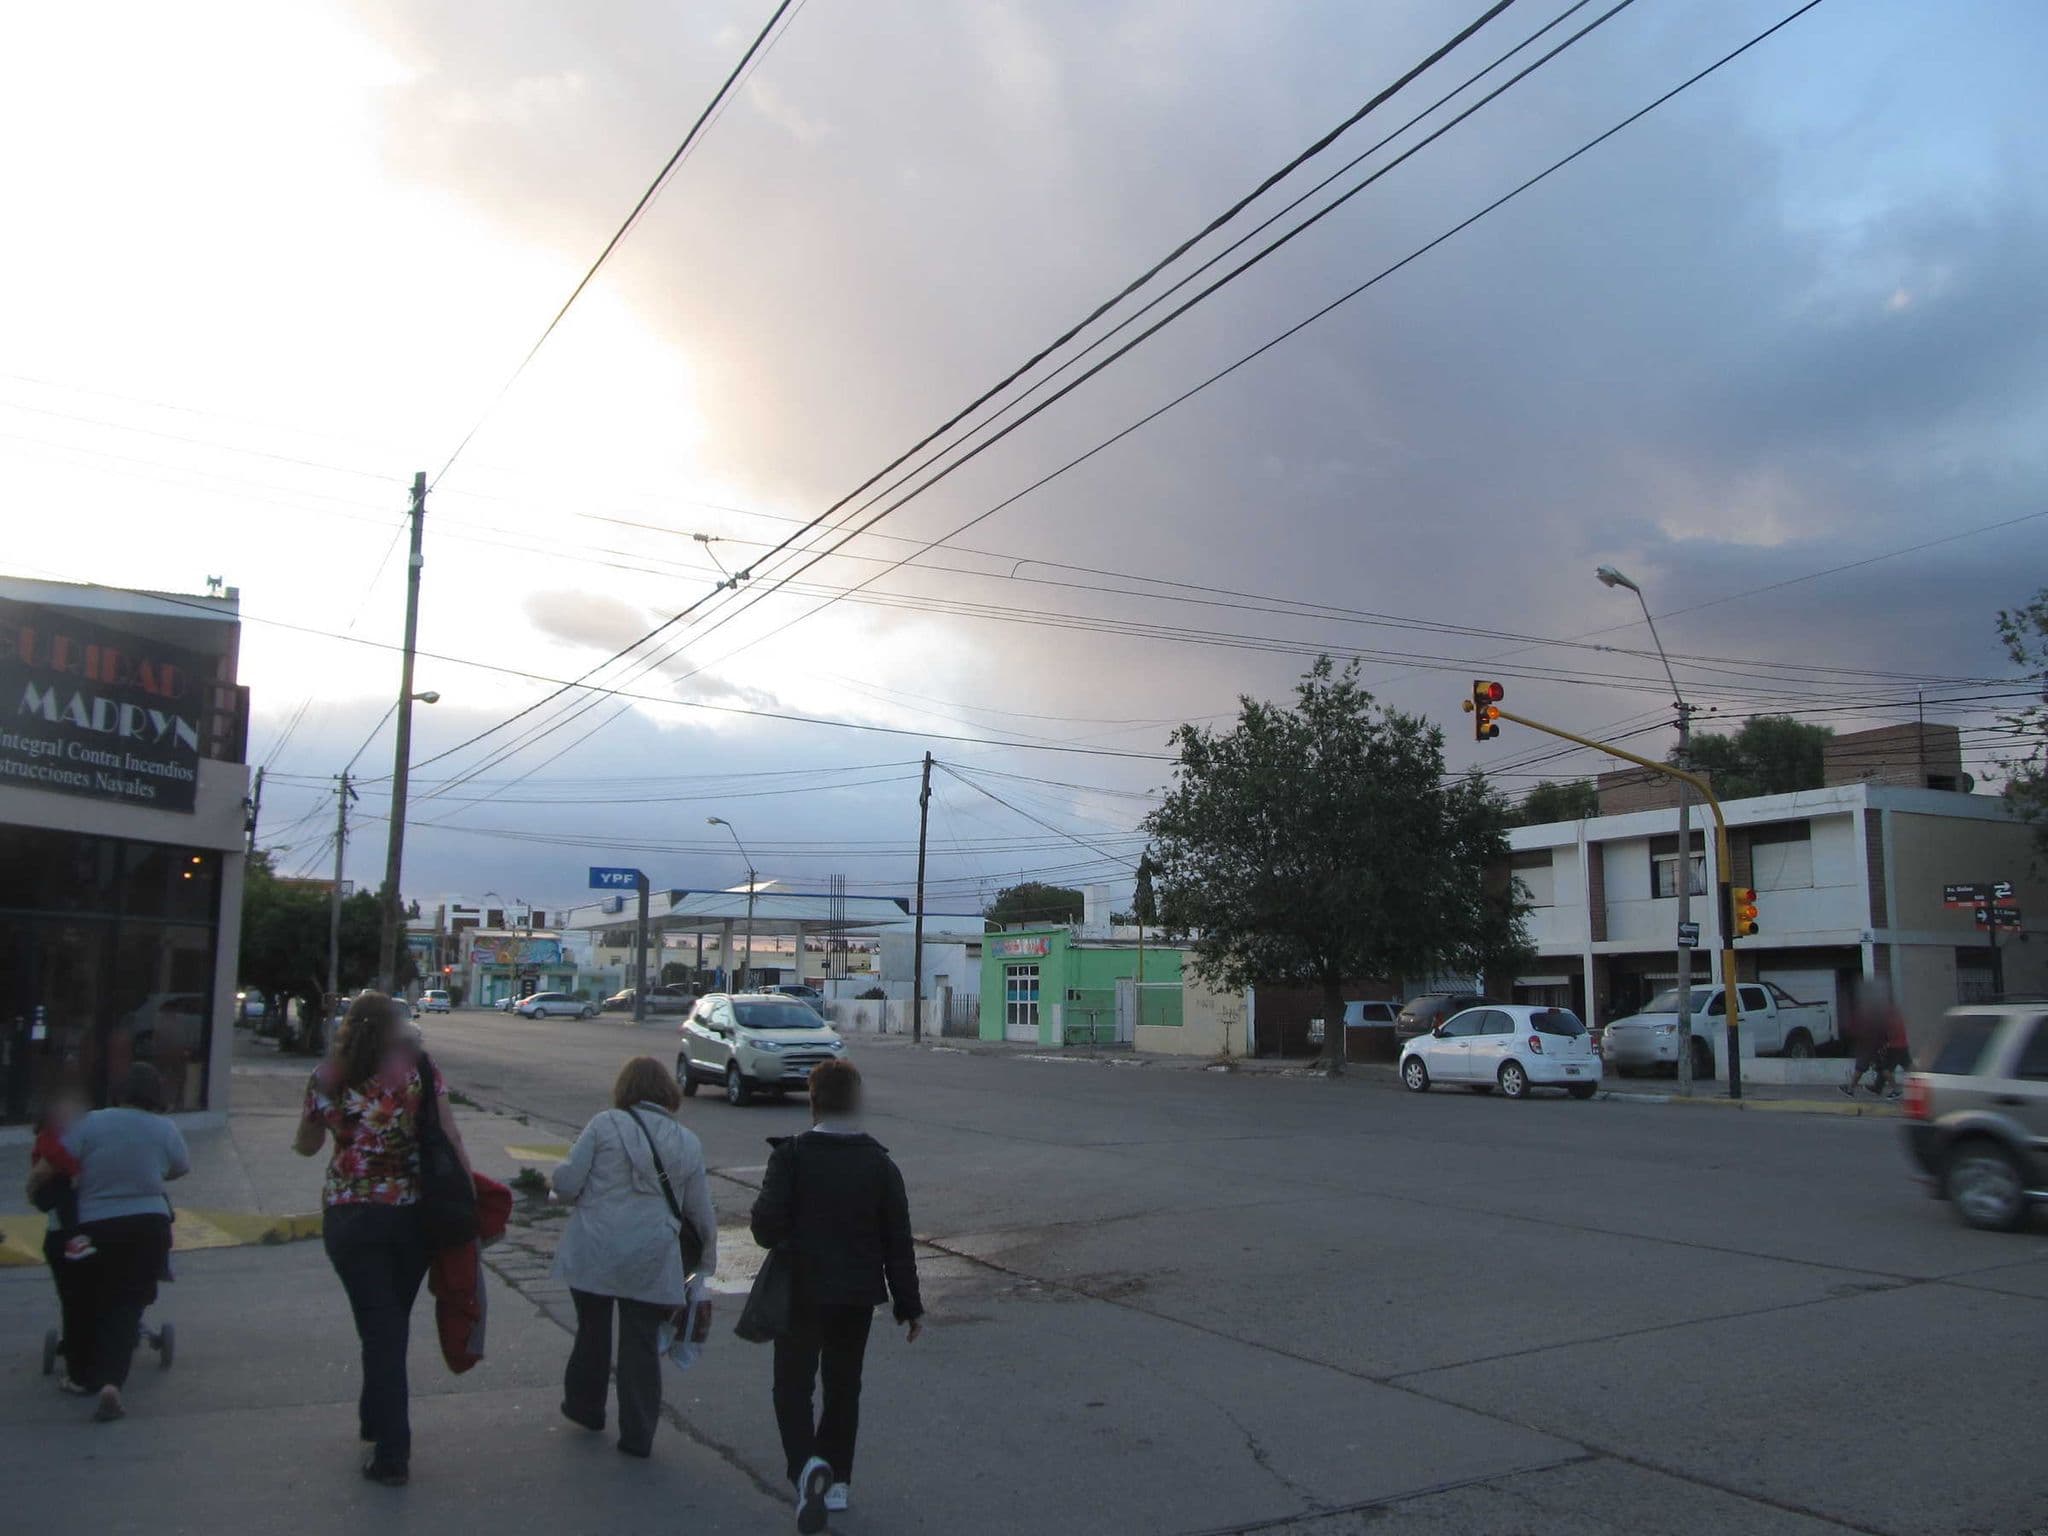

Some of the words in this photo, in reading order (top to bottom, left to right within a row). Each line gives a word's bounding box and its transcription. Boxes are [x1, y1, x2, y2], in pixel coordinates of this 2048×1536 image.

[18, 682, 200, 751] MADRYN
[0, 731, 63, 757] ntegral
[68, 741, 122, 768] Contra
[125, 753, 194, 781] Incendios
[95, 770, 155, 799] Navales
[600, 873, 634, 883] YPF
